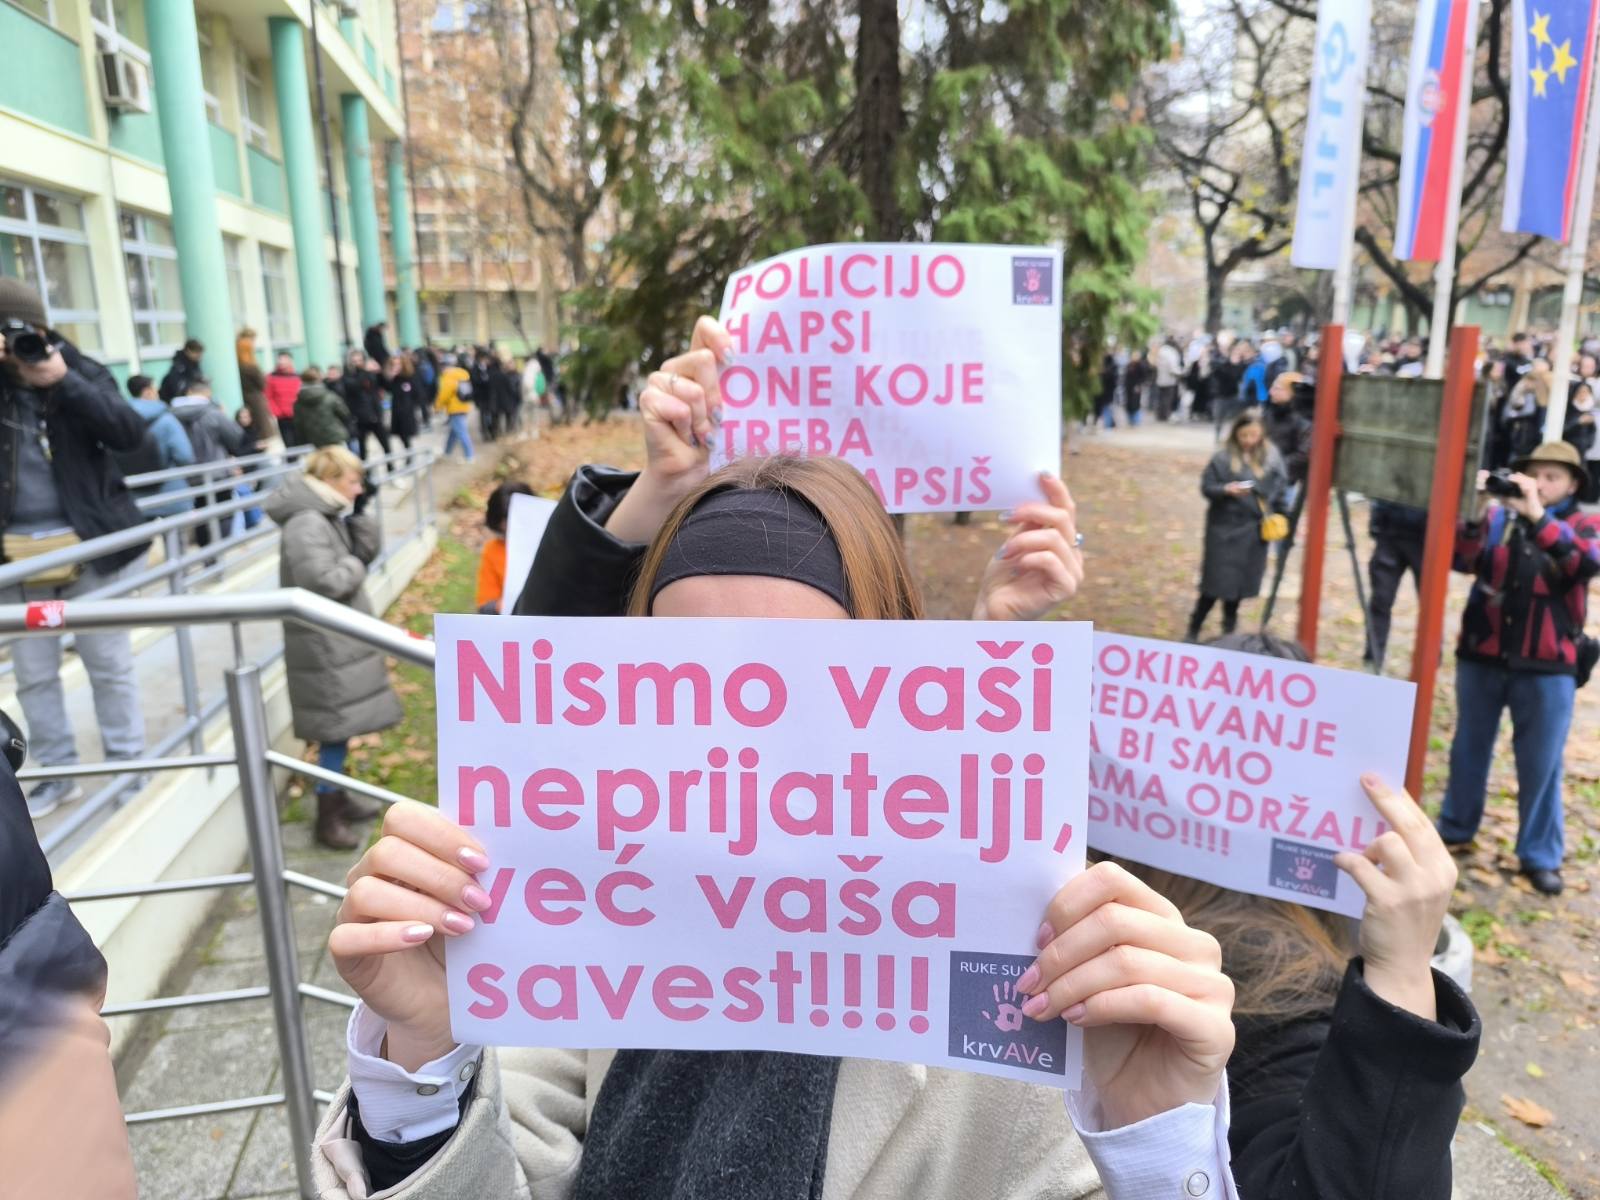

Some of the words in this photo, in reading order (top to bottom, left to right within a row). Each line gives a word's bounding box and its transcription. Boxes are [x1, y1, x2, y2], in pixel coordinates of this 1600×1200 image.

[729, 253, 965, 310] POLICIJO
[725, 310, 871, 355] HAPSI
[719, 365, 833, 409] ONE
[855, 363, 985, 408] KOJE
[720, 418, 874, 461] TREBA
[457, 639, 788, 729] Nismo
[828, 640, 1055, 733] vaši
[1092, 645, 1317, 708] OKIRAMO
[1118, 727, 1155, 763] BI
[1169, 737, 1273, 786] SMO
[457, 747, 1073, 864] neprijatelji,
[477, 843, 655, 927] već
[697, 855, 957, 938] vaša
[467, 951, 930, 1035] savest!!!!
[960, 961, 998, 975] RUKE
[1001, 964, 1021, 977] SU
[963, 1034, 1054, 1068] krvAVe
